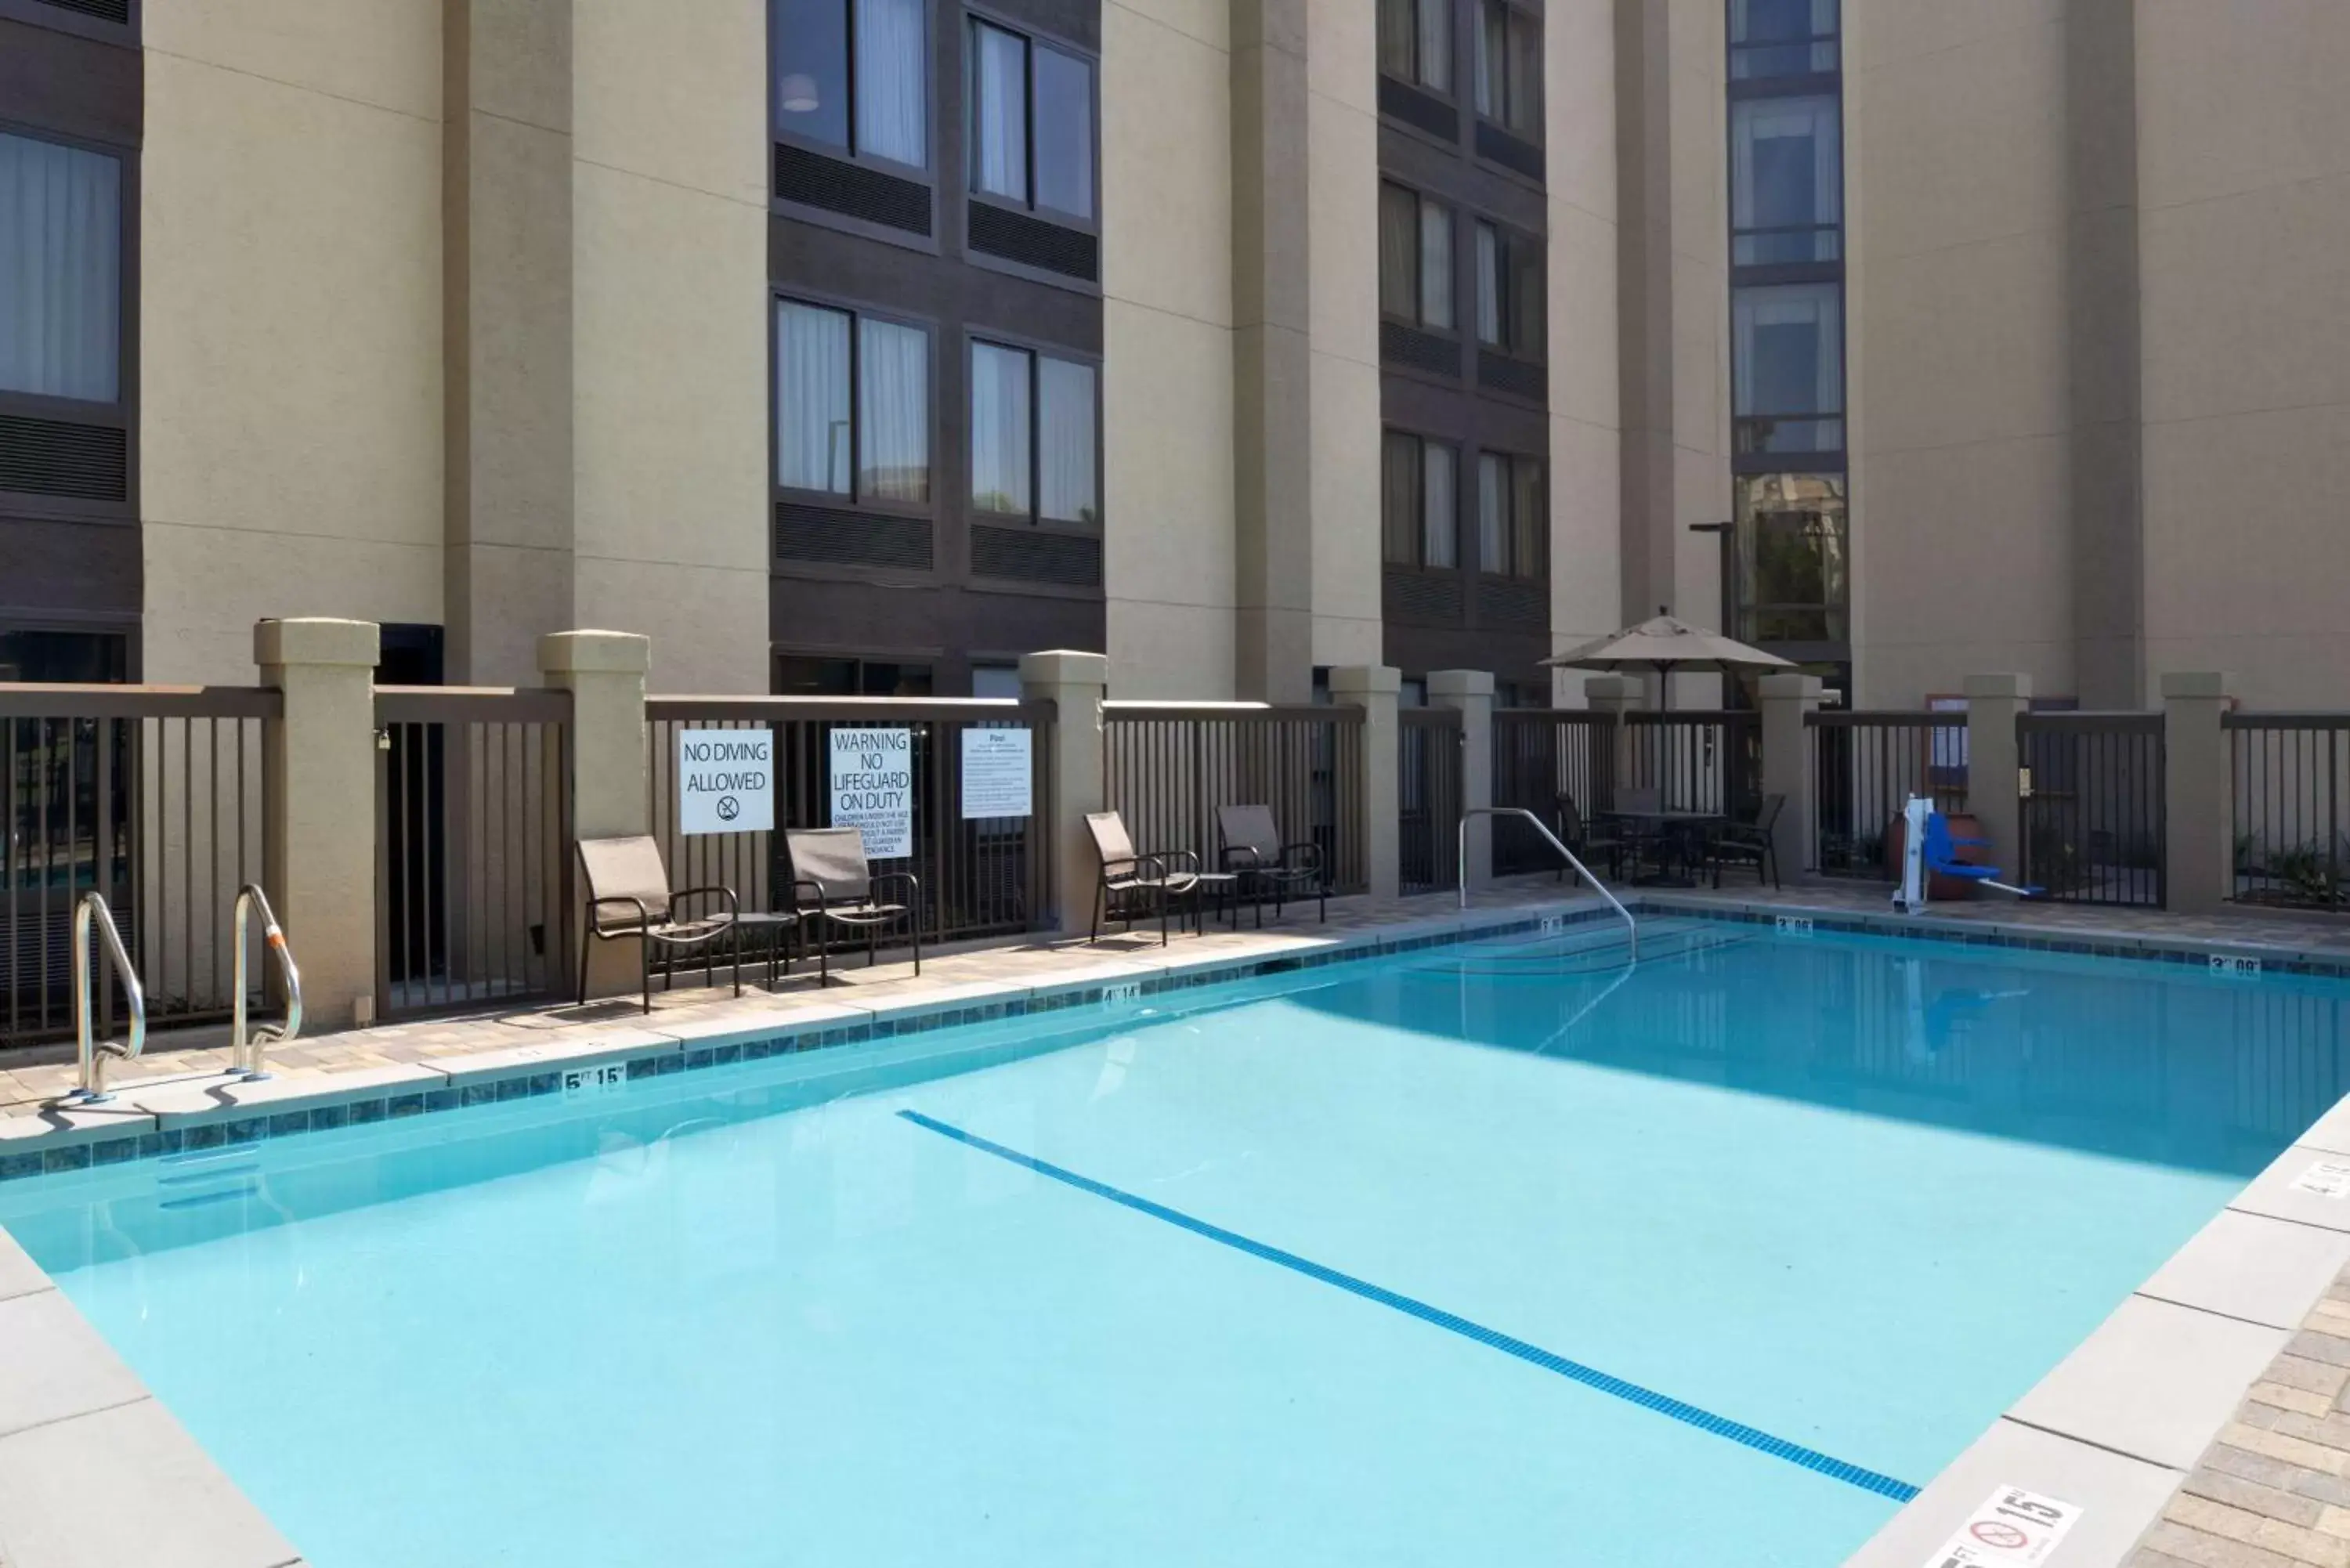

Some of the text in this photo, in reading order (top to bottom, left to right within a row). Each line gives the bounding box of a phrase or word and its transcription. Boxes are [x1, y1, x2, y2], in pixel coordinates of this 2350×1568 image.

[834, 732, 906, 751] WARNING
[685, 742, 768, 761] NO DIVING
[861, 753, 883, 770] NO
[687, 771, 765, 792] ALLOWED
[834, 771, 909, 791] LIFEGUARD
[841, 792, 903, 811] ON DUTY
[834, 813, 863, 822] CHILDREN
